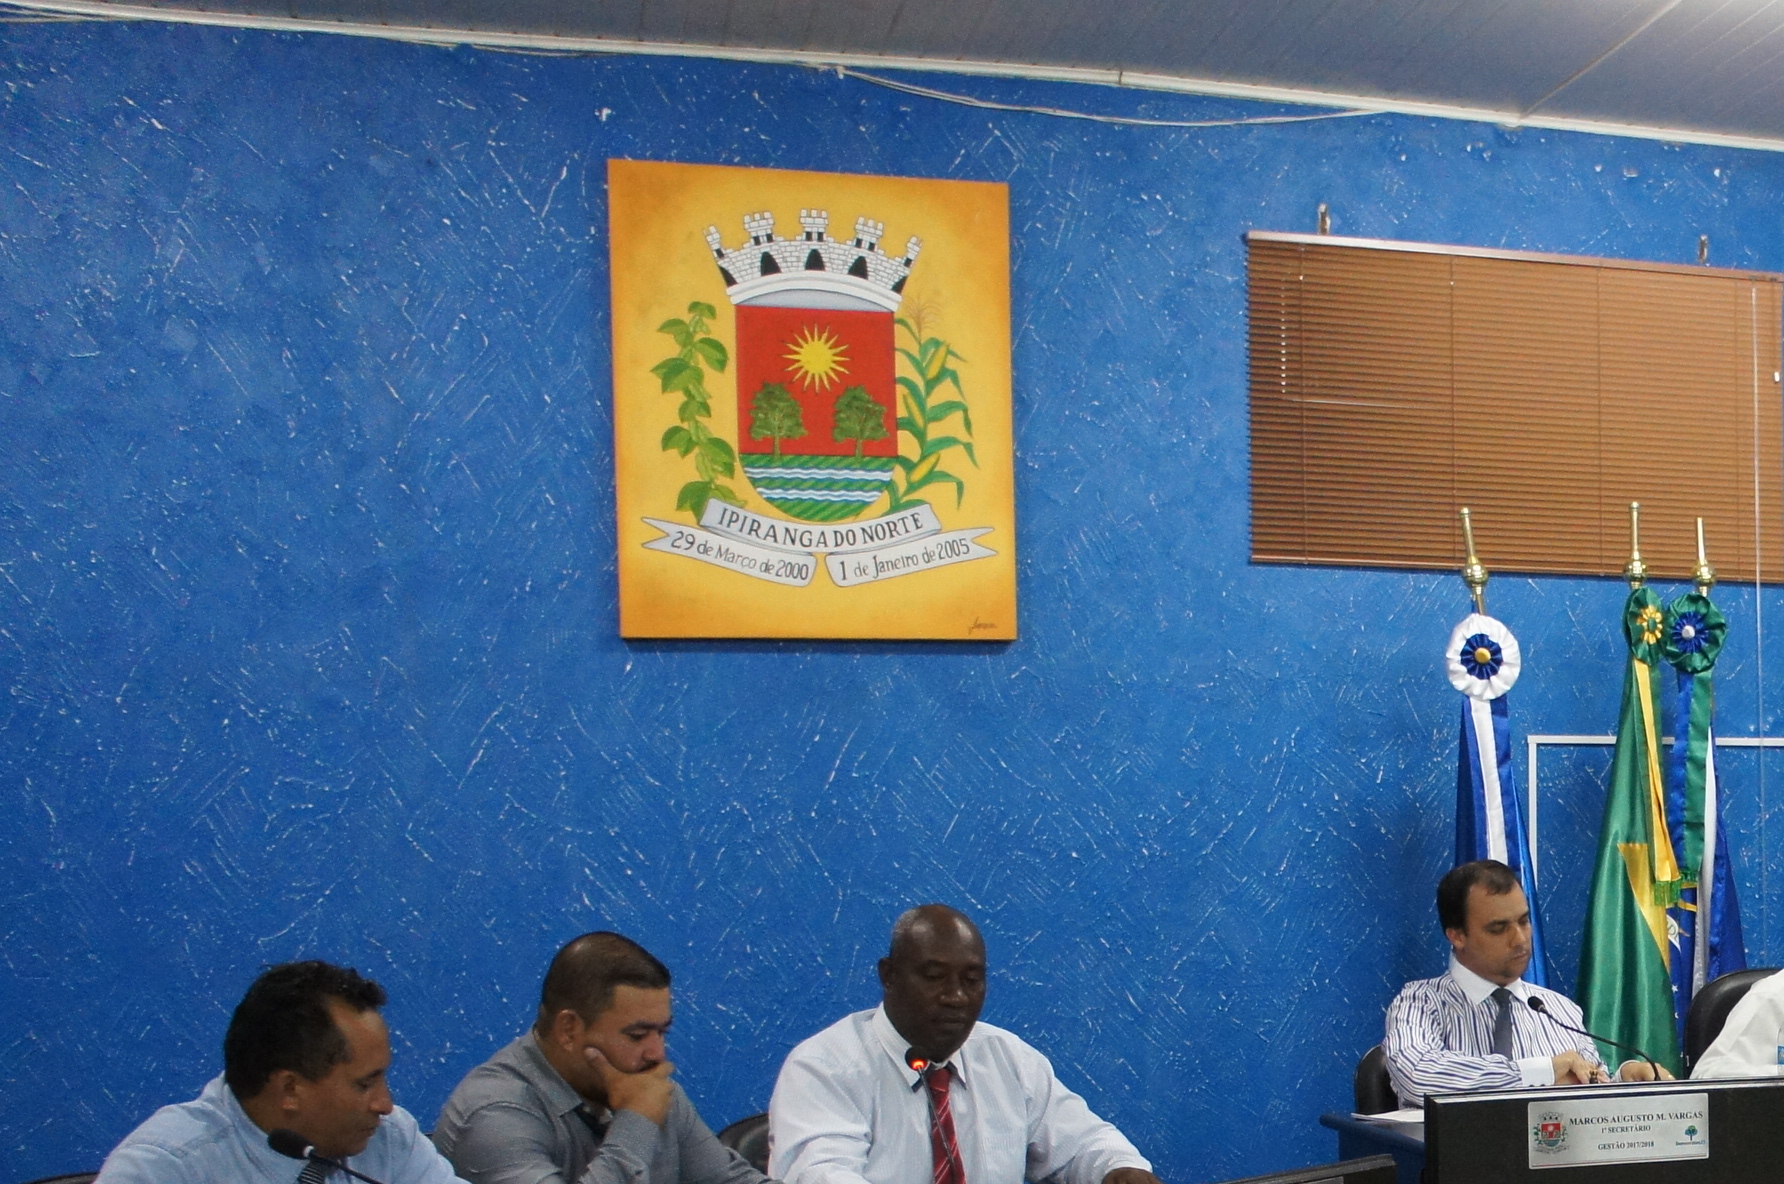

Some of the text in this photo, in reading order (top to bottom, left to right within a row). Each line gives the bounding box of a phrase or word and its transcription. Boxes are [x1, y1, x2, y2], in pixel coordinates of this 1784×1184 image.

[718, 507, 923, 548] IPIRANGA DO NORTE
[671, 531, 809, 580] 29 de Março de 2000
[839, 538, 970, 580] 1 de Janeiro de 2005
[1569, 1116, 1608, 1126] MARCOS
[1610, 1114, 1654, 1123] AUGUSTO
[1668, 1111, 1703, 1120] VARGAS
[1608, 1124, 1651, 1133] SECRETÁRIO
[1598, 1141, 1625, 1150] GESTÃO
